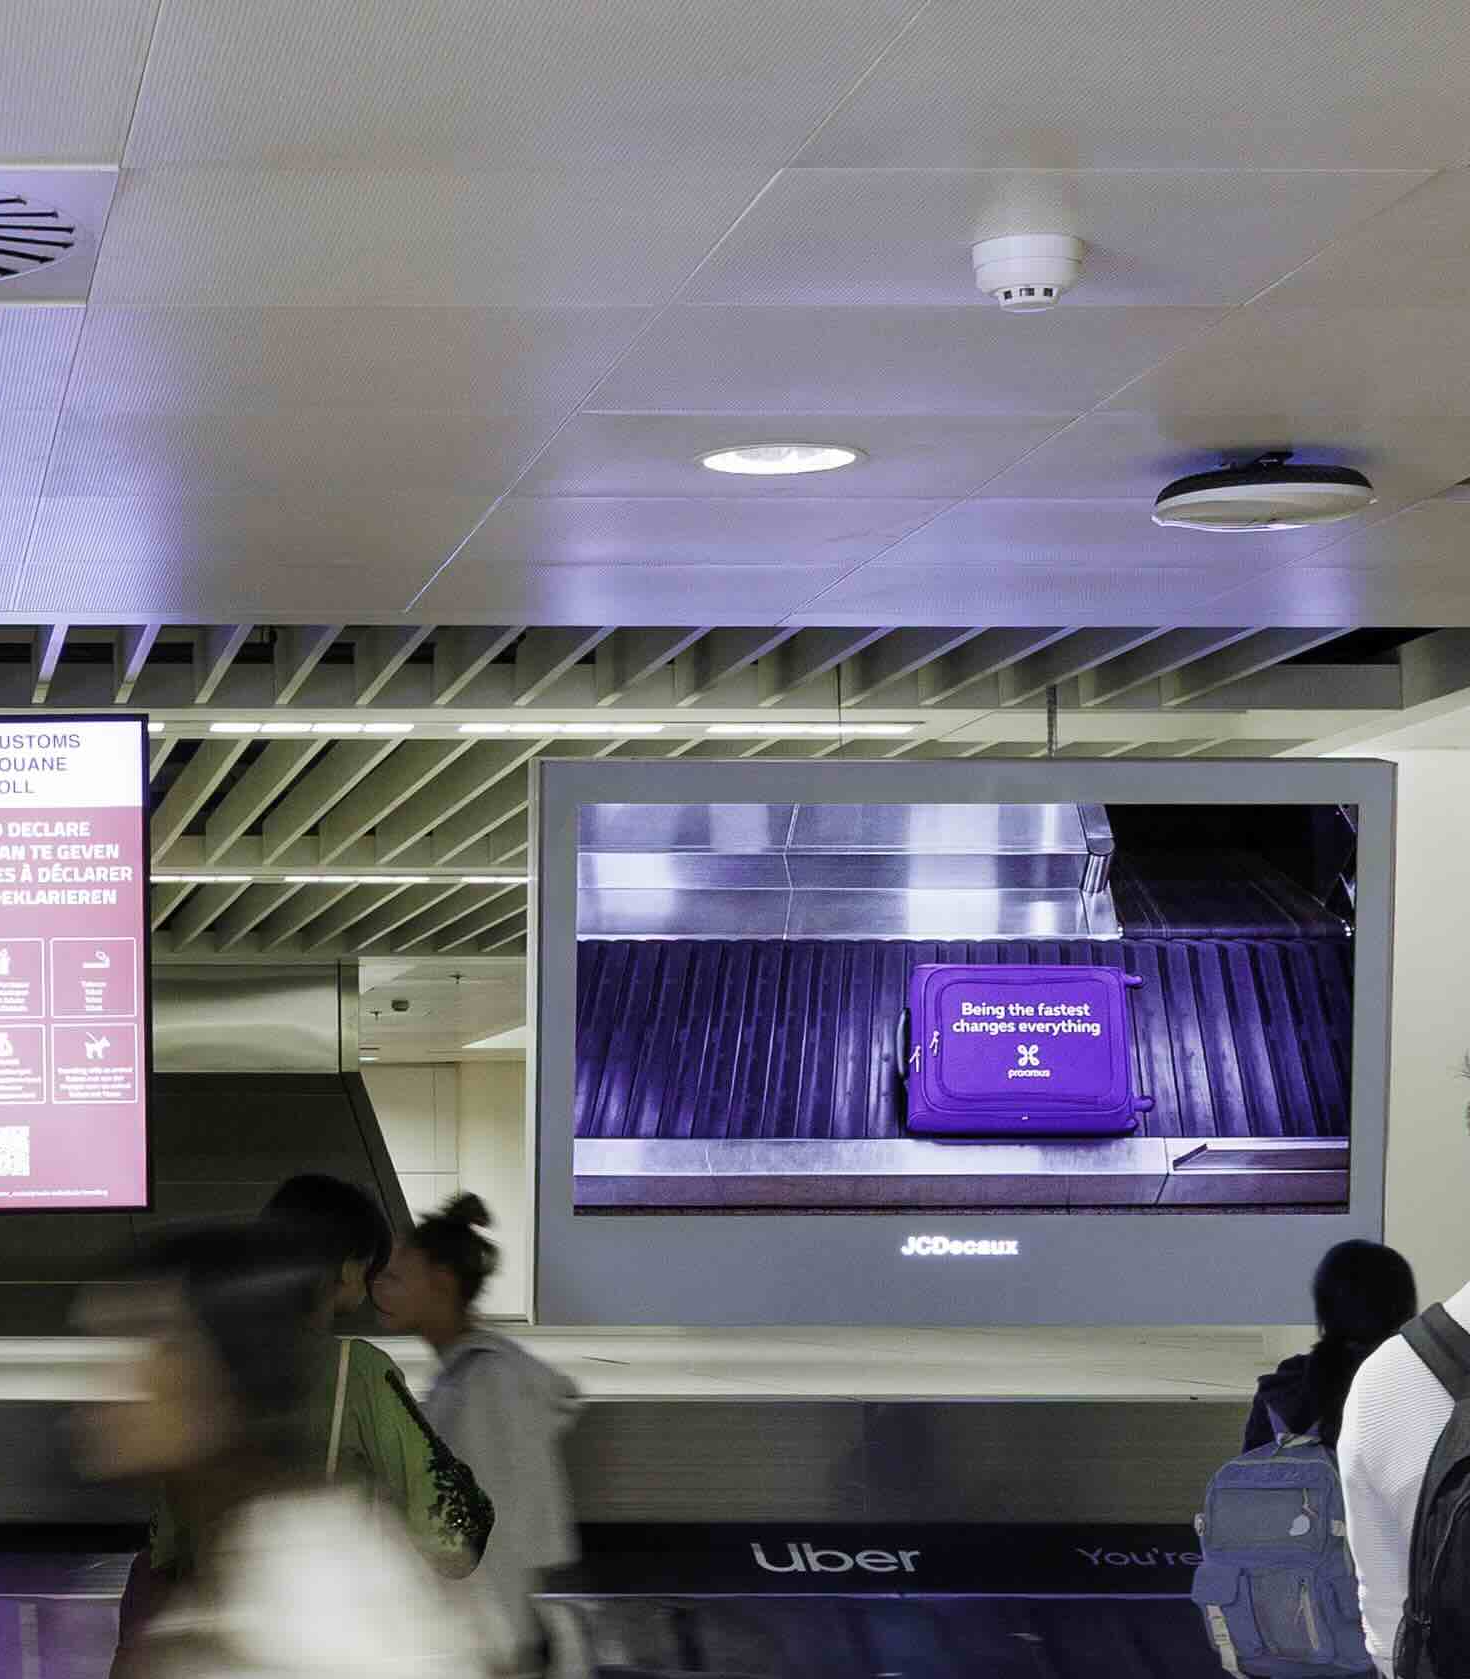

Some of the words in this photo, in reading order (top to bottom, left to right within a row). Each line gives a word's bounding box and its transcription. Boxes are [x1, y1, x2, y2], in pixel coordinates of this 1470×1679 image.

[7, 821, 91, 839] DECLARE
[31, 844, 53, 861] TE
[57, 843, 120, 861] GEVEN
[20, 862, 33, 884] À
[37, 862, 133, 884] DÉCLARER
[961, 1003, 1005, 1019] Being
[1008, 1003, 1034, 1017] the
[1037, 1003, 1091, 1017] fastest
[952, 1019, 1016, 1036] changes
[1018, 1019, 1102, 1037] everything
[900, 1235, 1019, 1256] JCDecaux
[750, 1542, 921, 1573] Uber
